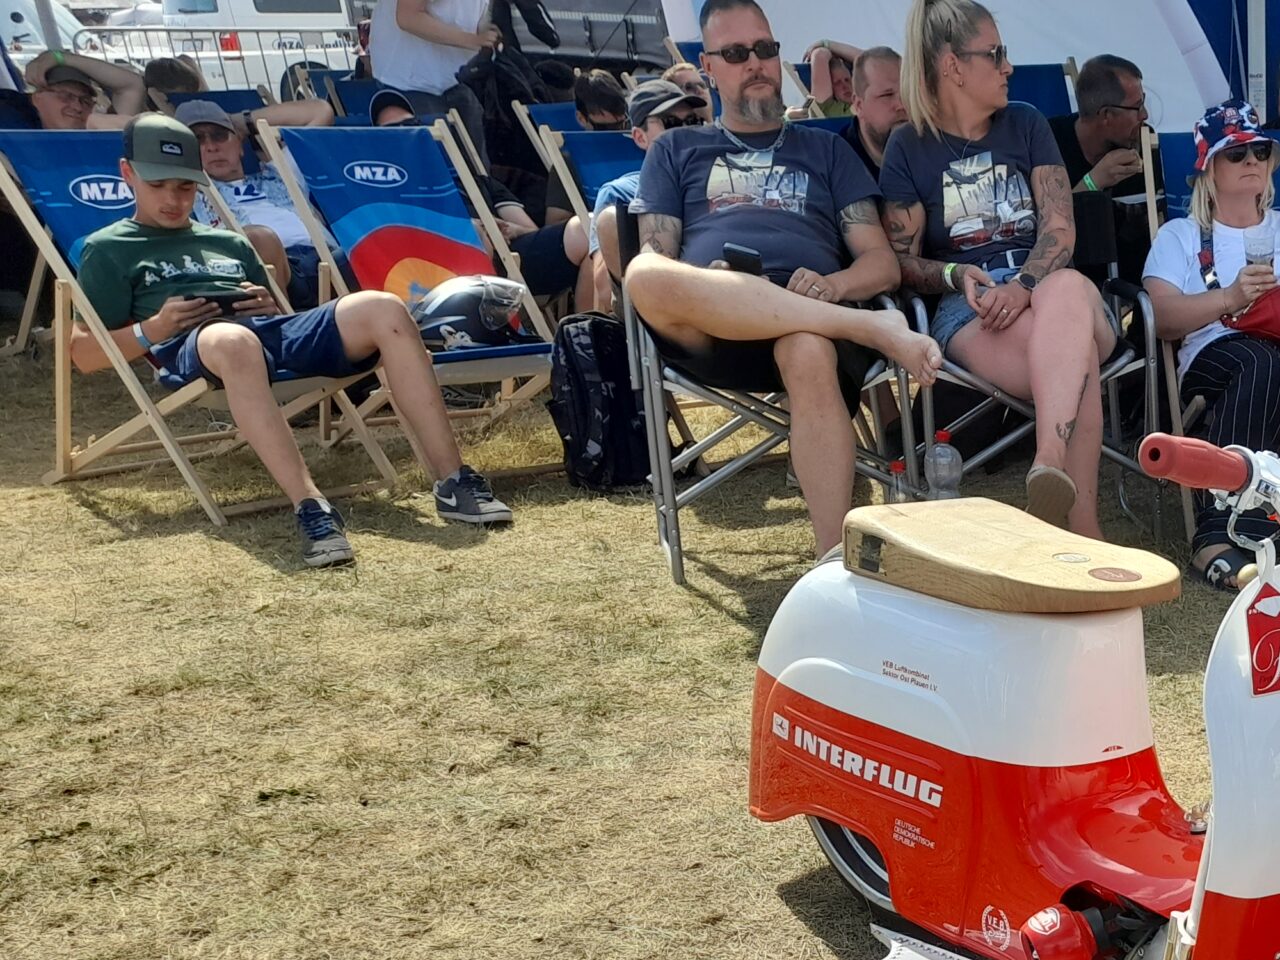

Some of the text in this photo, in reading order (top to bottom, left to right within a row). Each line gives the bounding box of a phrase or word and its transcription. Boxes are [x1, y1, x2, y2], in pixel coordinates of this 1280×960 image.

[354, 166, 402, 180] MZA
[80, 182, 135, 200] MZA
[794, 725, 944, 809] INTERFLUG
